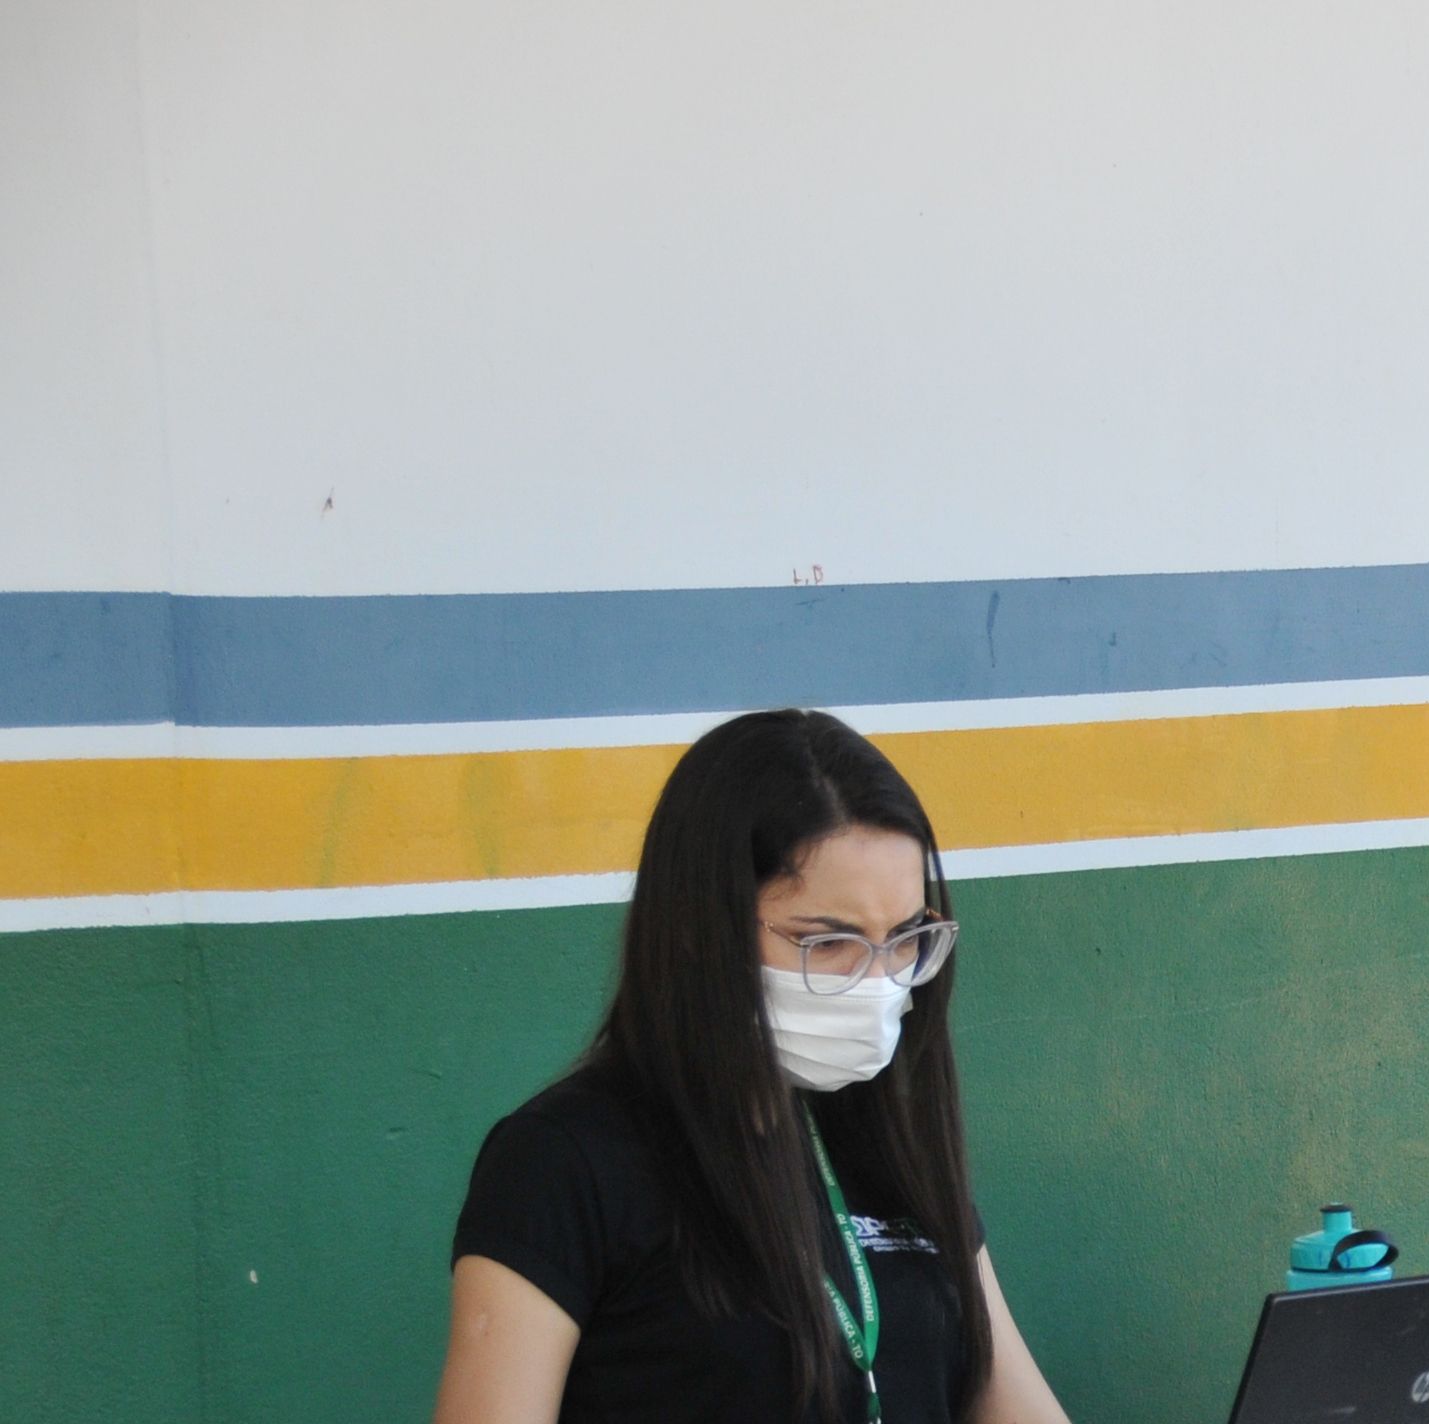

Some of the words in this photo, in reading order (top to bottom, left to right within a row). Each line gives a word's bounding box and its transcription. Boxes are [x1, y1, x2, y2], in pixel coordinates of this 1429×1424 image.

[856, 1266, 875, 1322] DEFENSORIA
[833, 1298, 855, 1339] PÚBLICA
[852, 1344, 864, 1359] TO
